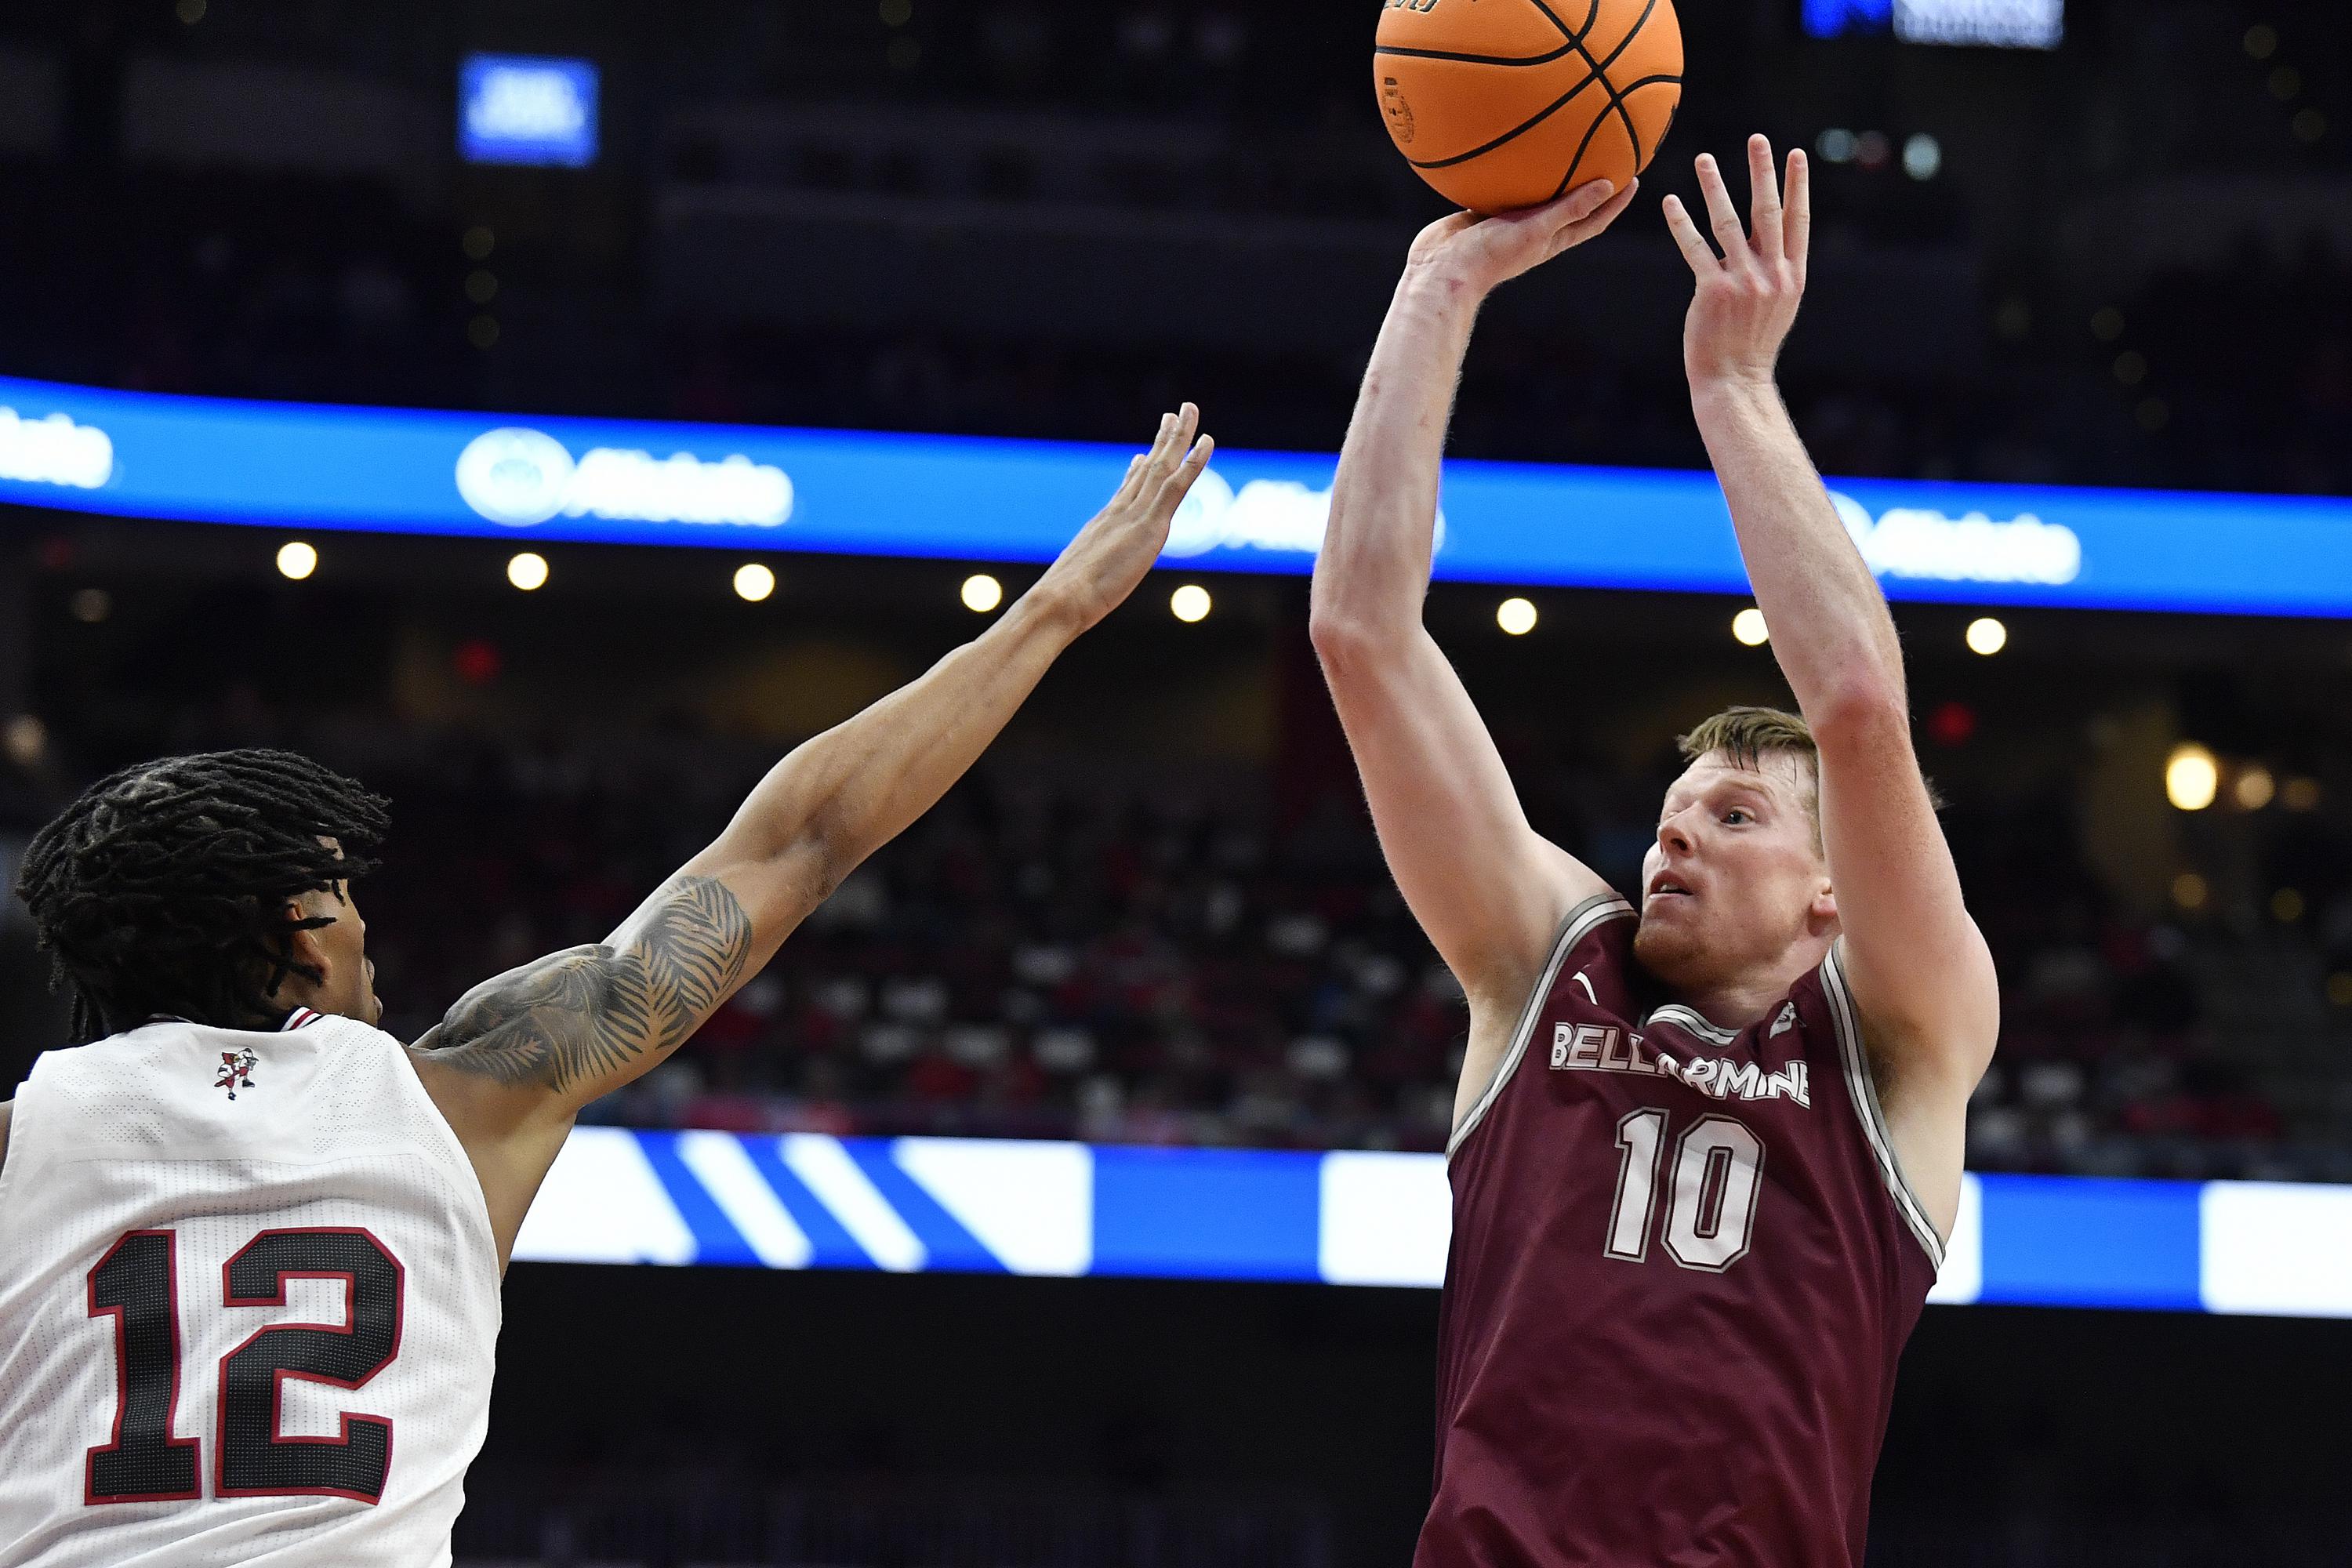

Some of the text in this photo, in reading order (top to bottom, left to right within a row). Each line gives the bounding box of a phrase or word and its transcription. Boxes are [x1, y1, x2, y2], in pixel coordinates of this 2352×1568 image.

[1549, 1022, 1810, 1109] BELLARMINE
[1603, 1106, 1766, 1274] 10
[85, 1227, 405, 1506] 12
